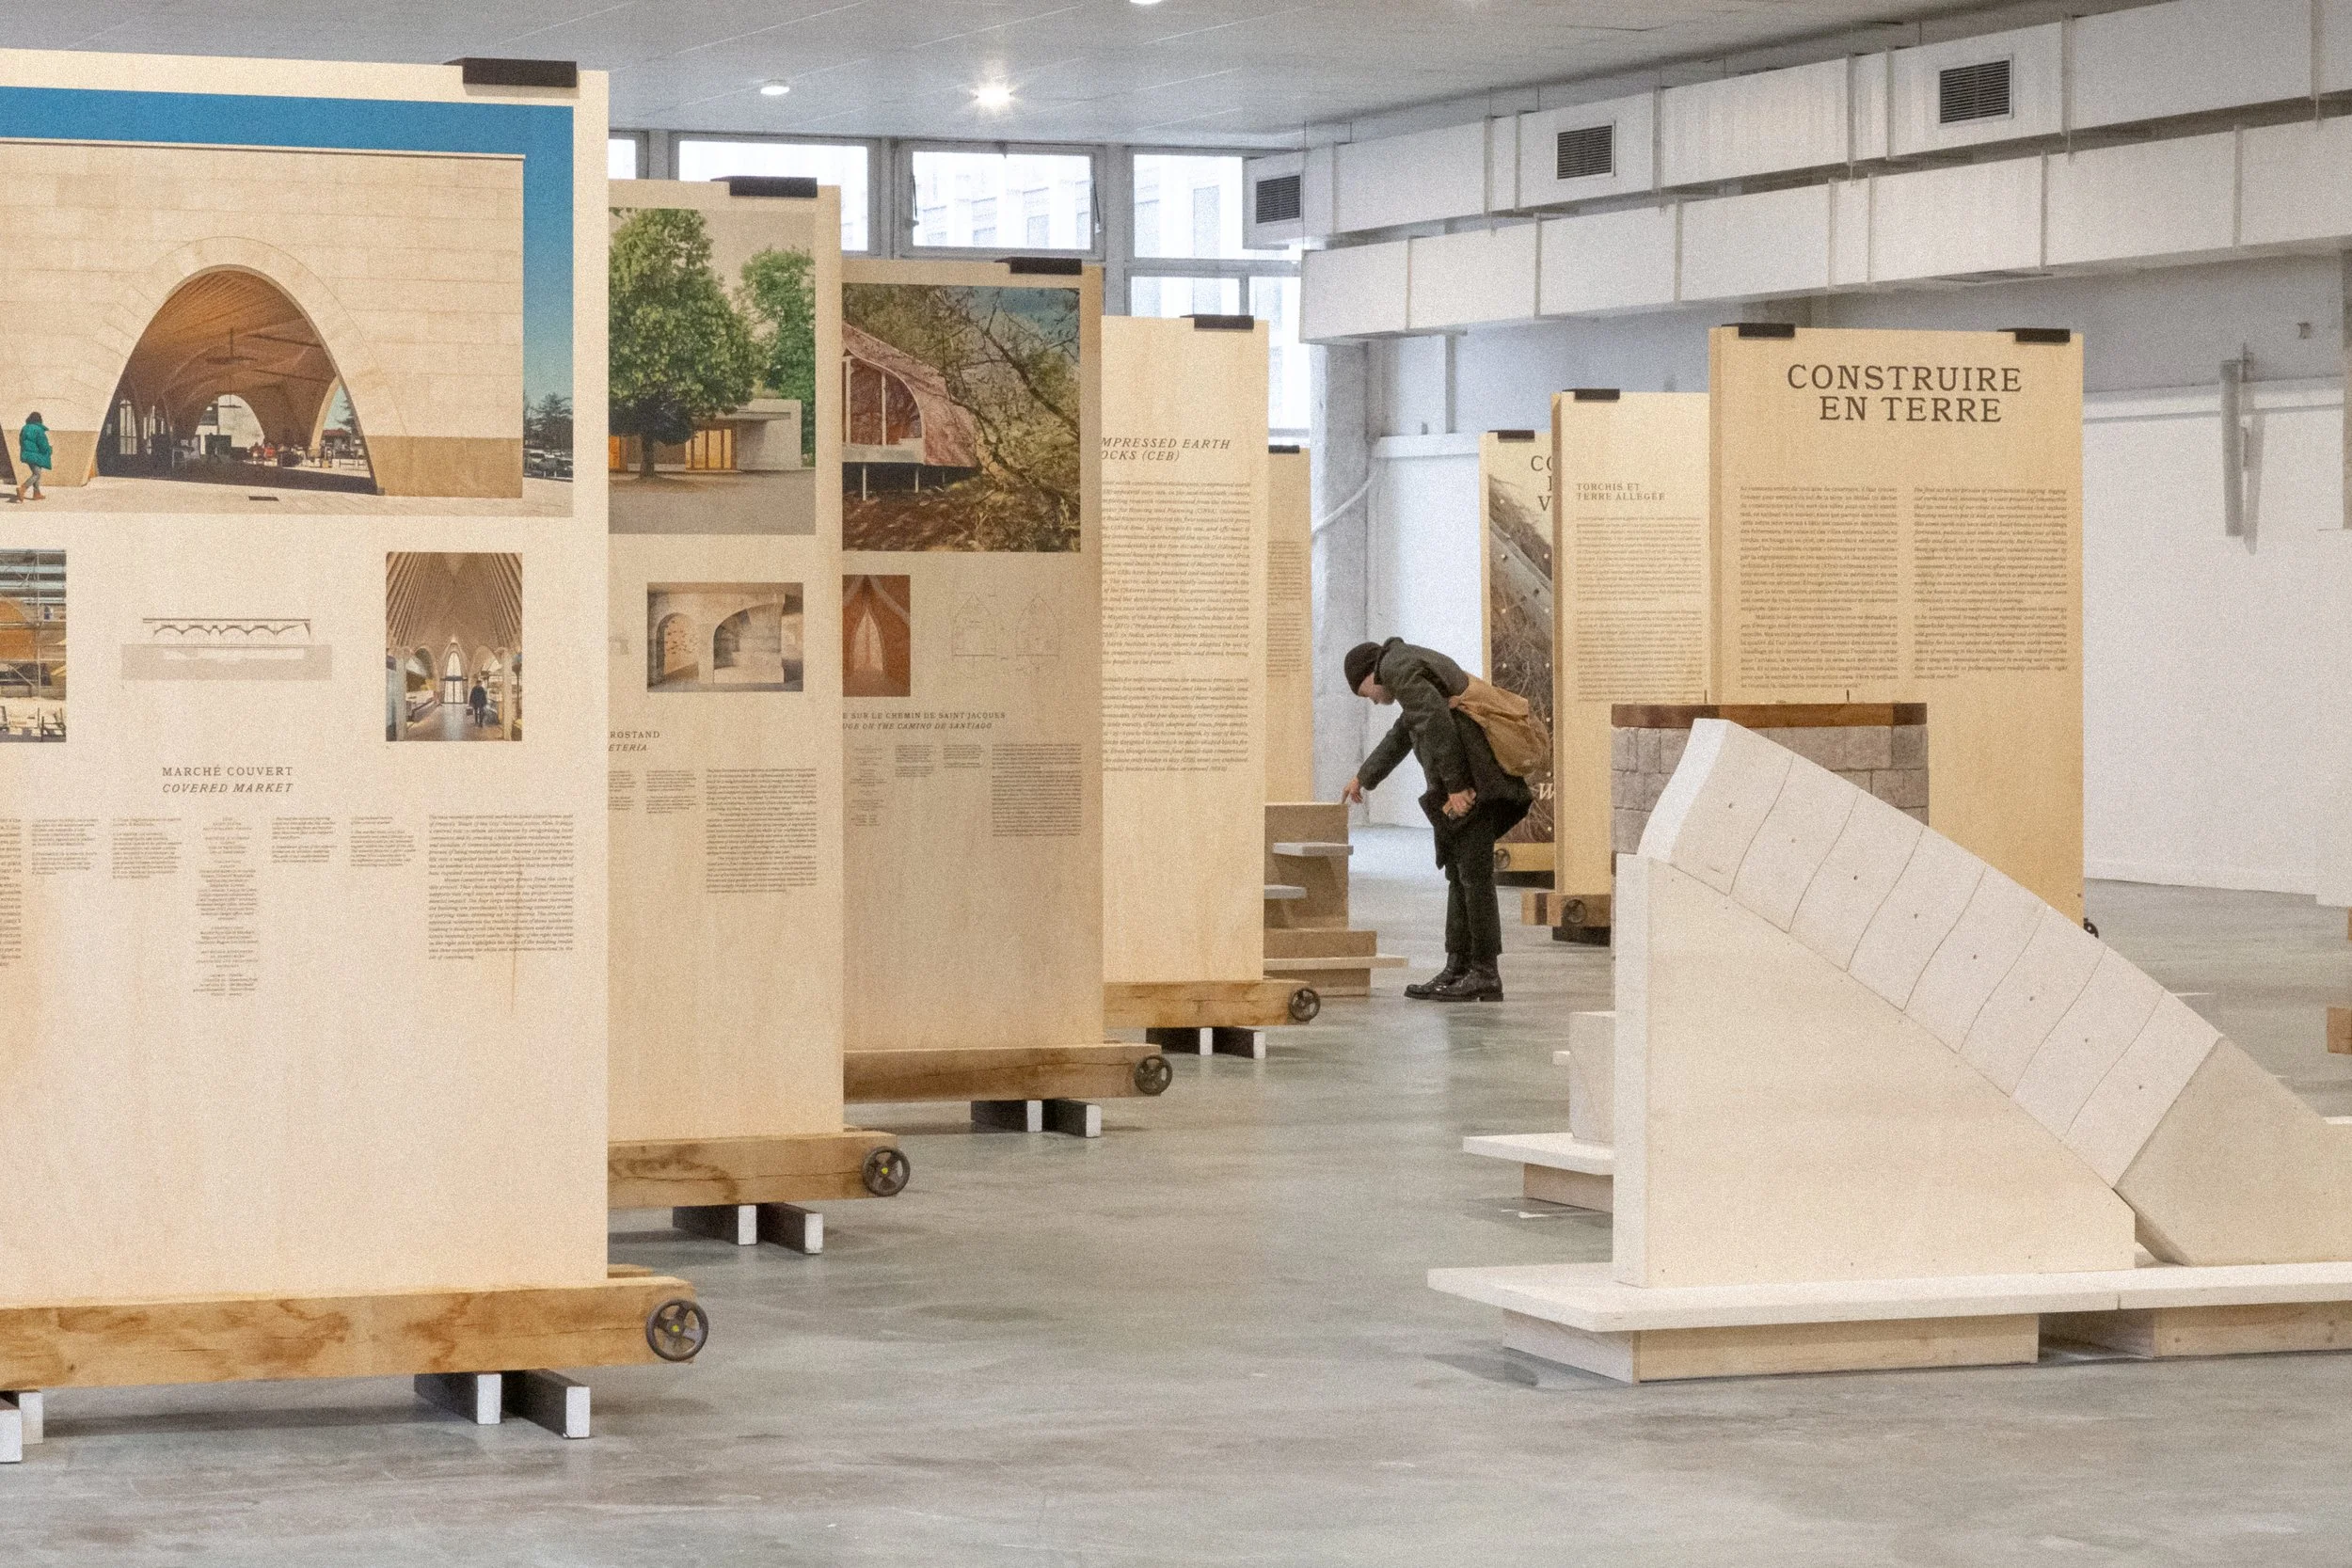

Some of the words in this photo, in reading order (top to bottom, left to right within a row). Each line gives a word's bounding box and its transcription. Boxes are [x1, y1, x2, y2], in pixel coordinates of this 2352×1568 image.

[1788, 364, 2023, 392] CONSTRUIRE
[1819, 395, 1868, 420] EN
[1880, 397, 2002, 422] TERRE
[1182, 439, 1231, 449] EARTH
[1141, 451, 1180, 461] (CEB)
[1576, 483, 1623, 491] TORCHIS
[1627, 483, 1640, 491] ET
[1576, 492, 1612, 500] TERRE
[162, 765, 221, 776] MARCHÉ
[227, 767, 294, 776] COUVERT
[162, 784, 229, 793] COVERED
[233, 783, 294, 793] MARKET
